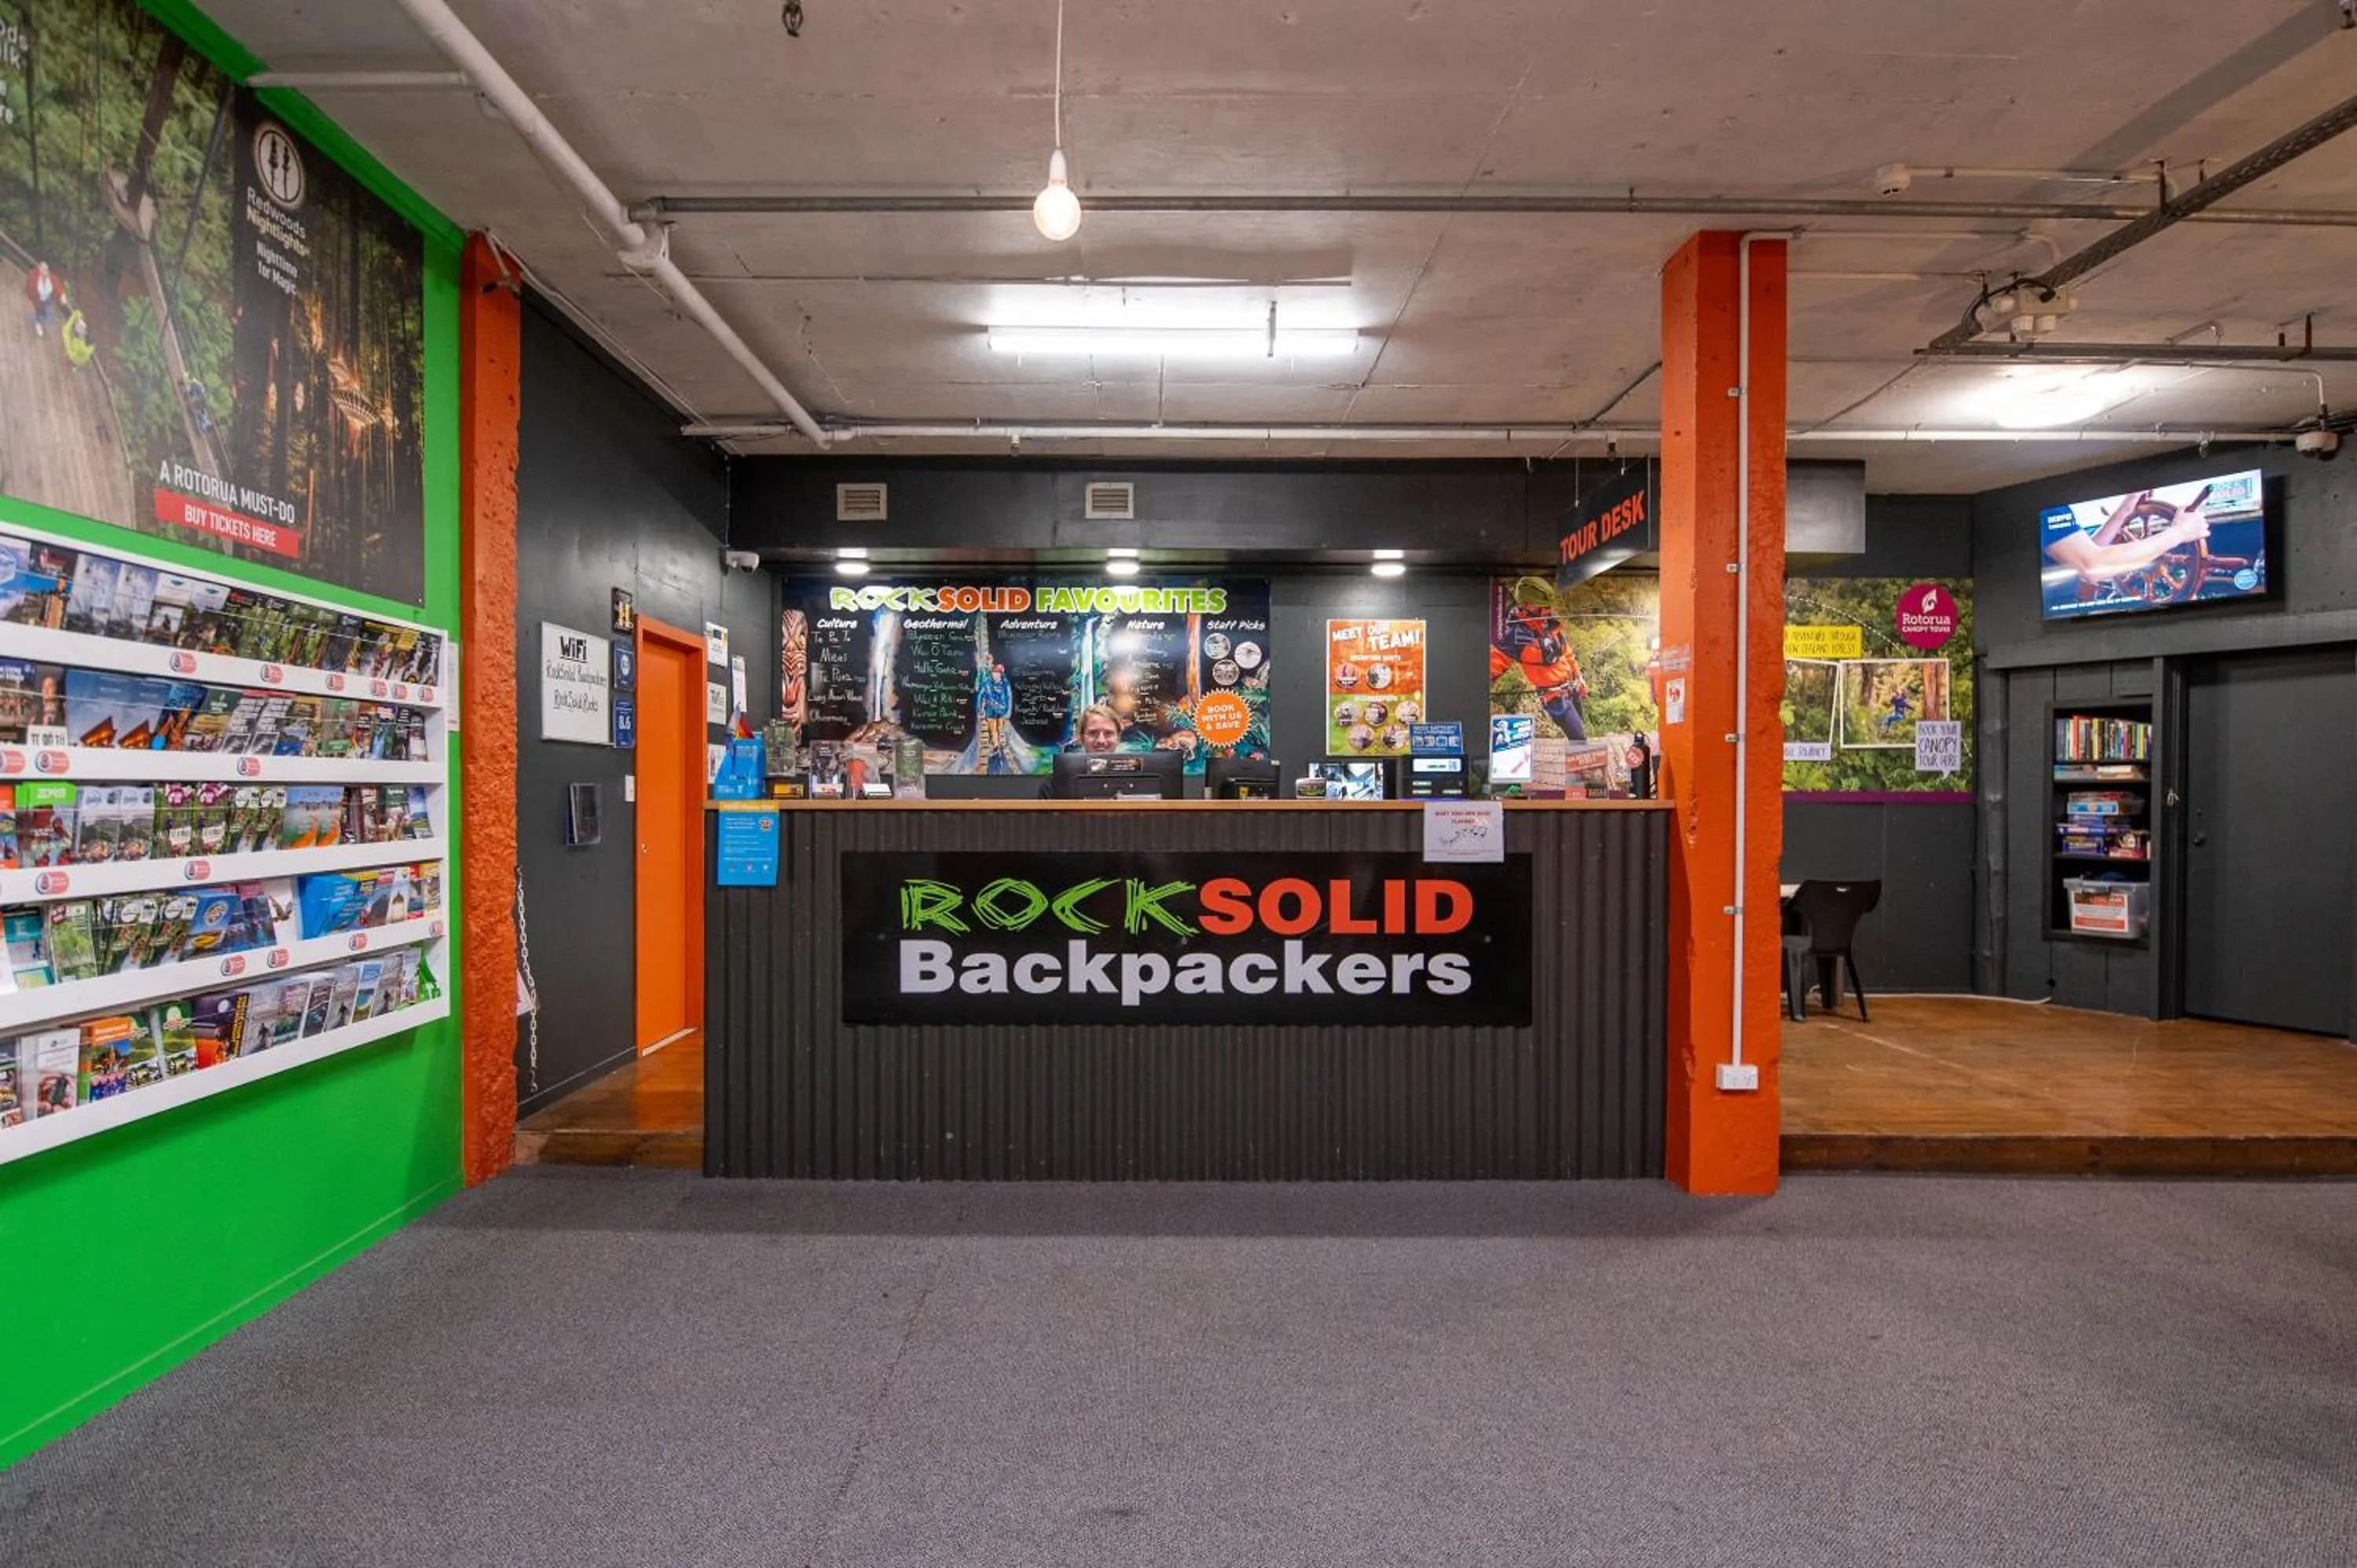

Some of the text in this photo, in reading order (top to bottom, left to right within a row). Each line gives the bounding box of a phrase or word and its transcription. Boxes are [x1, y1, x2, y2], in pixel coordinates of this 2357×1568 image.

[247, 185, 306, 239] Redwoods
[258, 261, 296, 295] for Magic
[159, 460, 295, 524] A ROTORUA MUST-DO
[185, 503, 277, 548] BUY TICKETS HERE
[1560, 490, 1644, 564] TOUR DESK
[1036, 587, 1227, 614] FAVOURITES
[817, 618, 858, 628] Culture
[903, 618, 969, 629] Geothermal
[1000, 619, 1058, 629] Adventure
[1127, 619, 1165, 629] Nature
[1207, 620, 1266, 631] Staff Picks
[1902, 613, 1951, 625] Rotorua
[1332, 627, 1362, 641] MEET
[1369, 629, 1420, 653] TEAM!
[560, 636, 587, 661] WiFi
[1206, 703, 1236, 714] BOOK
[1202, 712, 1243, 723] WITH US
[1215, 720, 1241, 731] SAVE
[1919, 736, 1957, 754] CANOPY
[900, 940, 1472, 1006] Backpackers
